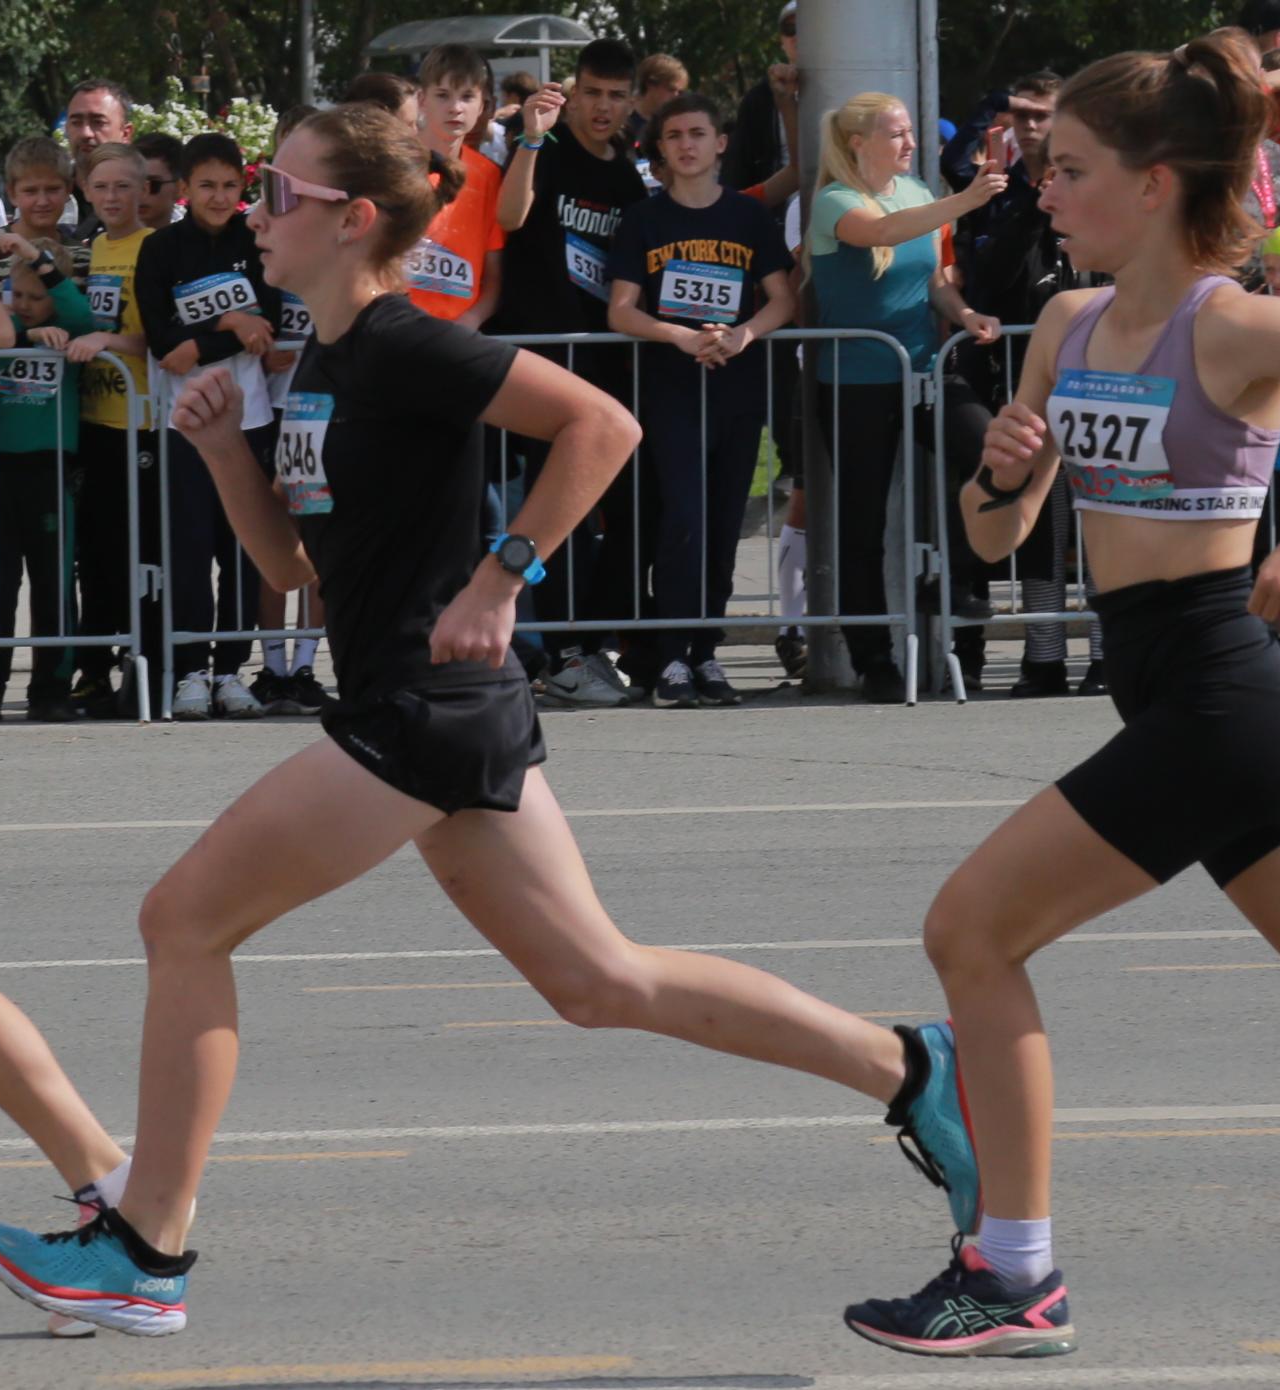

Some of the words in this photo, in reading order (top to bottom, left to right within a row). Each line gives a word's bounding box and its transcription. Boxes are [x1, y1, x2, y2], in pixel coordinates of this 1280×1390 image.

[575, 254, 606, 286] 531
[677, 239, 719, 262] YORK
[720, 240, 754, 271] CITY
[184, 284, 248, 320] 5308
[673, 278, 731, 306] 5315
[1060, 410, 1150, 462] 2327
[1196, 497, 1235, 510] STAR
[133, 1278, 175, 1293] HOKA
